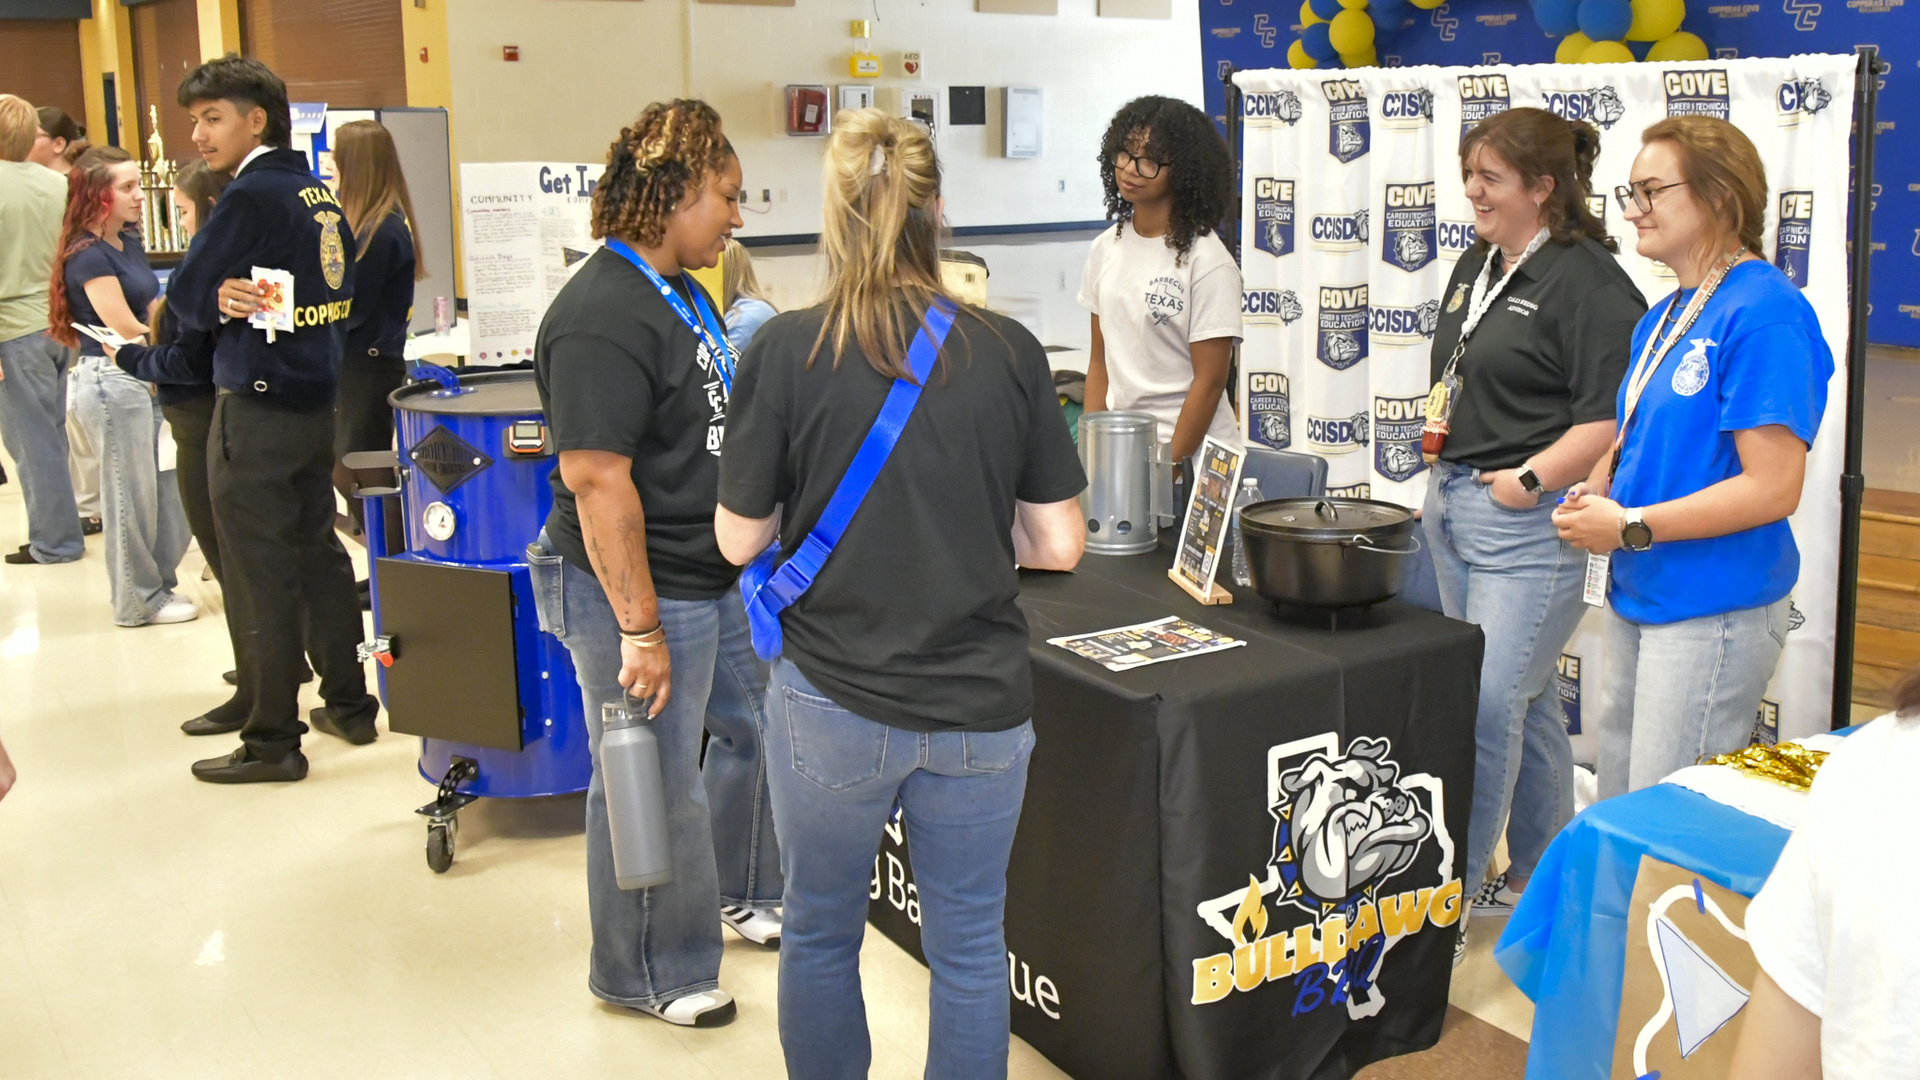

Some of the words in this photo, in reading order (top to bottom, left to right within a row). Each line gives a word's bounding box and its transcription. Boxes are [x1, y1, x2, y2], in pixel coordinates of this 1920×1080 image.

[1458, 76, 1509, 99] COVE
[1665, 72, 1727, 97] COVE
[1696, 102, 1729, 111] TECHNICAL
[539, 166, 571, 195] Get
[298, 187, 342, 208] TEXAS
[470, 195, 533, 205] COMMUNITY
[1386, 185, 1435, 208] COVE
[1312, 216, 1356, 240] CCISD
[1388, 216, 1434, 228] EDUCATION
[1439, 222, 1476, 249] CCIS
[1149, 277, 1184, 295] BARBECUE
[1145, 292, 1184, 311] TEXAS
[1320, 286, 1367, 310] COVE
[1679, 292, 1704, 326] HOUSTON
[1320, 318, 1365, 329] EDUCATION
[1341, 311, 1368, 320] TECHNICAL
[1376, 398, 1427, 420] COVE
[1307, 417, 1352, 443] CCISD
[1376, 431, 1424, 440] EDUCATION
[1191, 877, 1463, 1006] BULLDAWG
